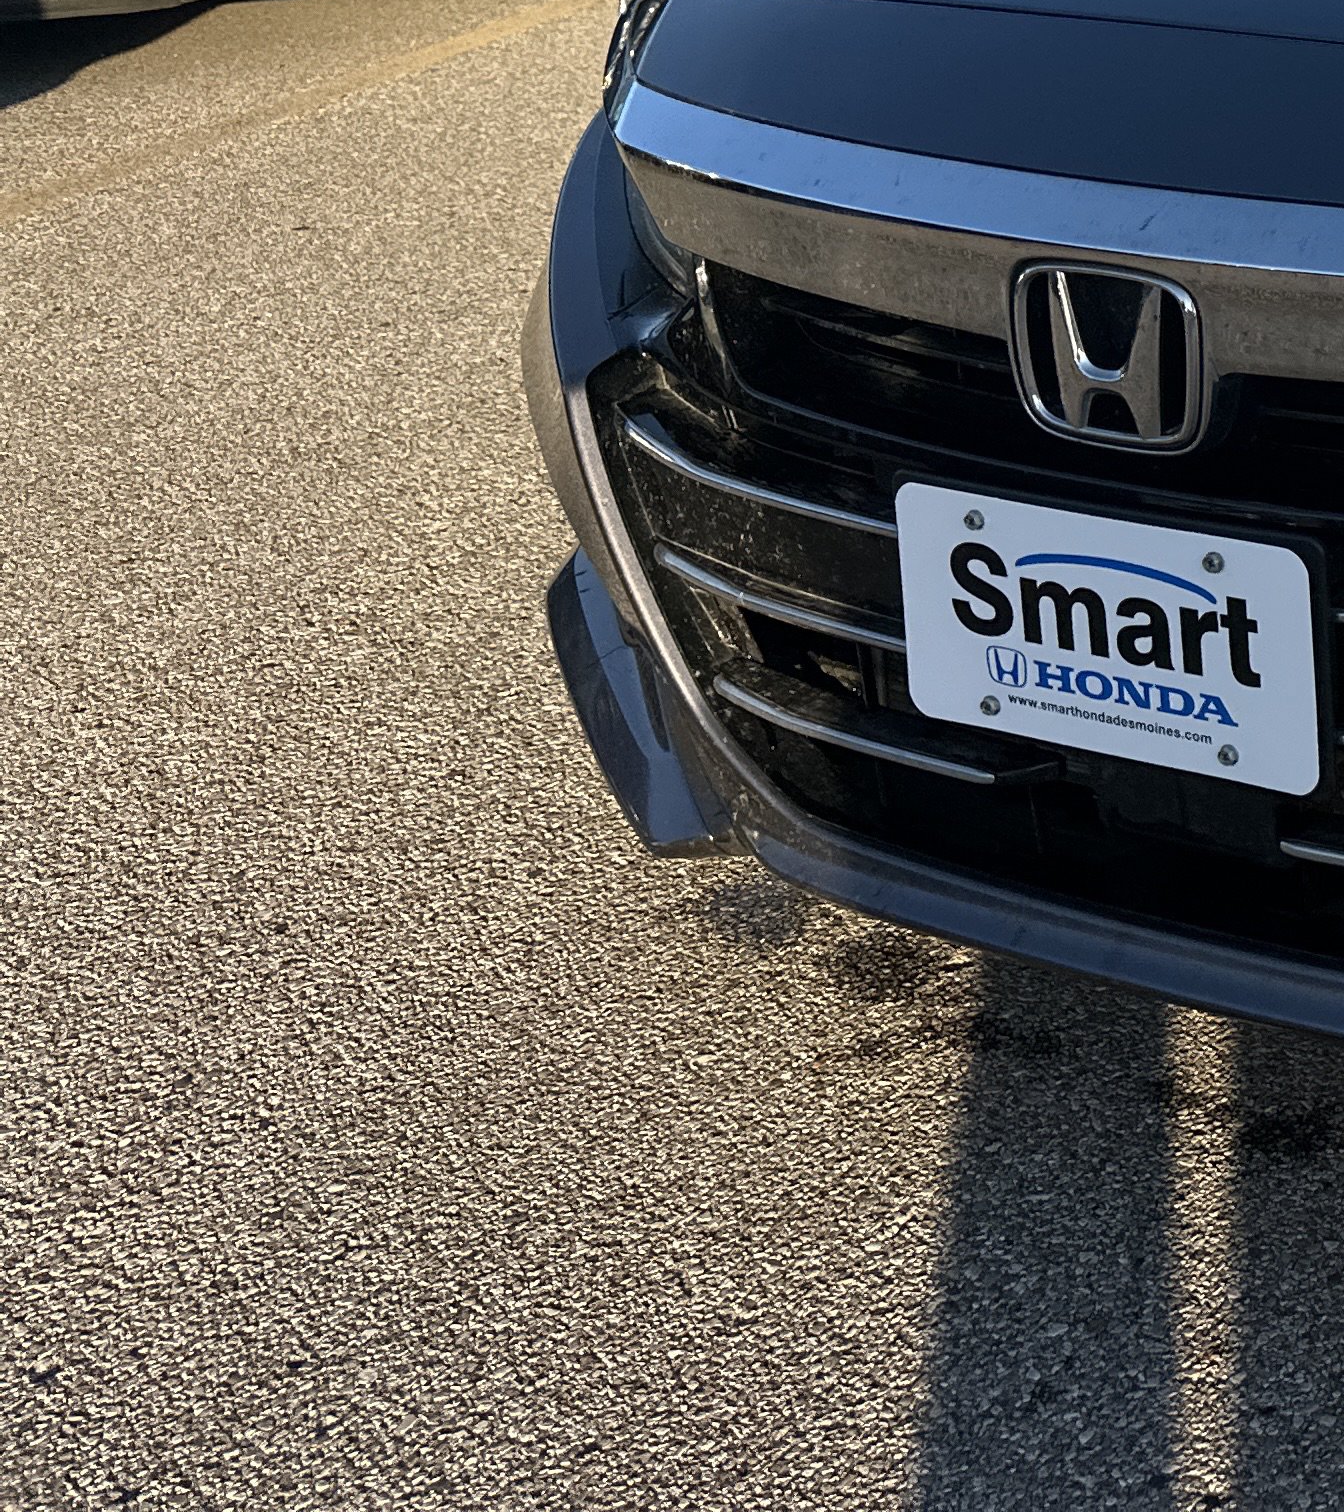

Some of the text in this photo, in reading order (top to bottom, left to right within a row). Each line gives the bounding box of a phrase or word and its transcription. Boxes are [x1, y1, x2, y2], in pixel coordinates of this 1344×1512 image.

[950, 542, 1261, 688] Smart
[1008, 694, 1212, 745] www.smarthondadesmoines.com
[1033, 660, 1239, 727] HONDA
